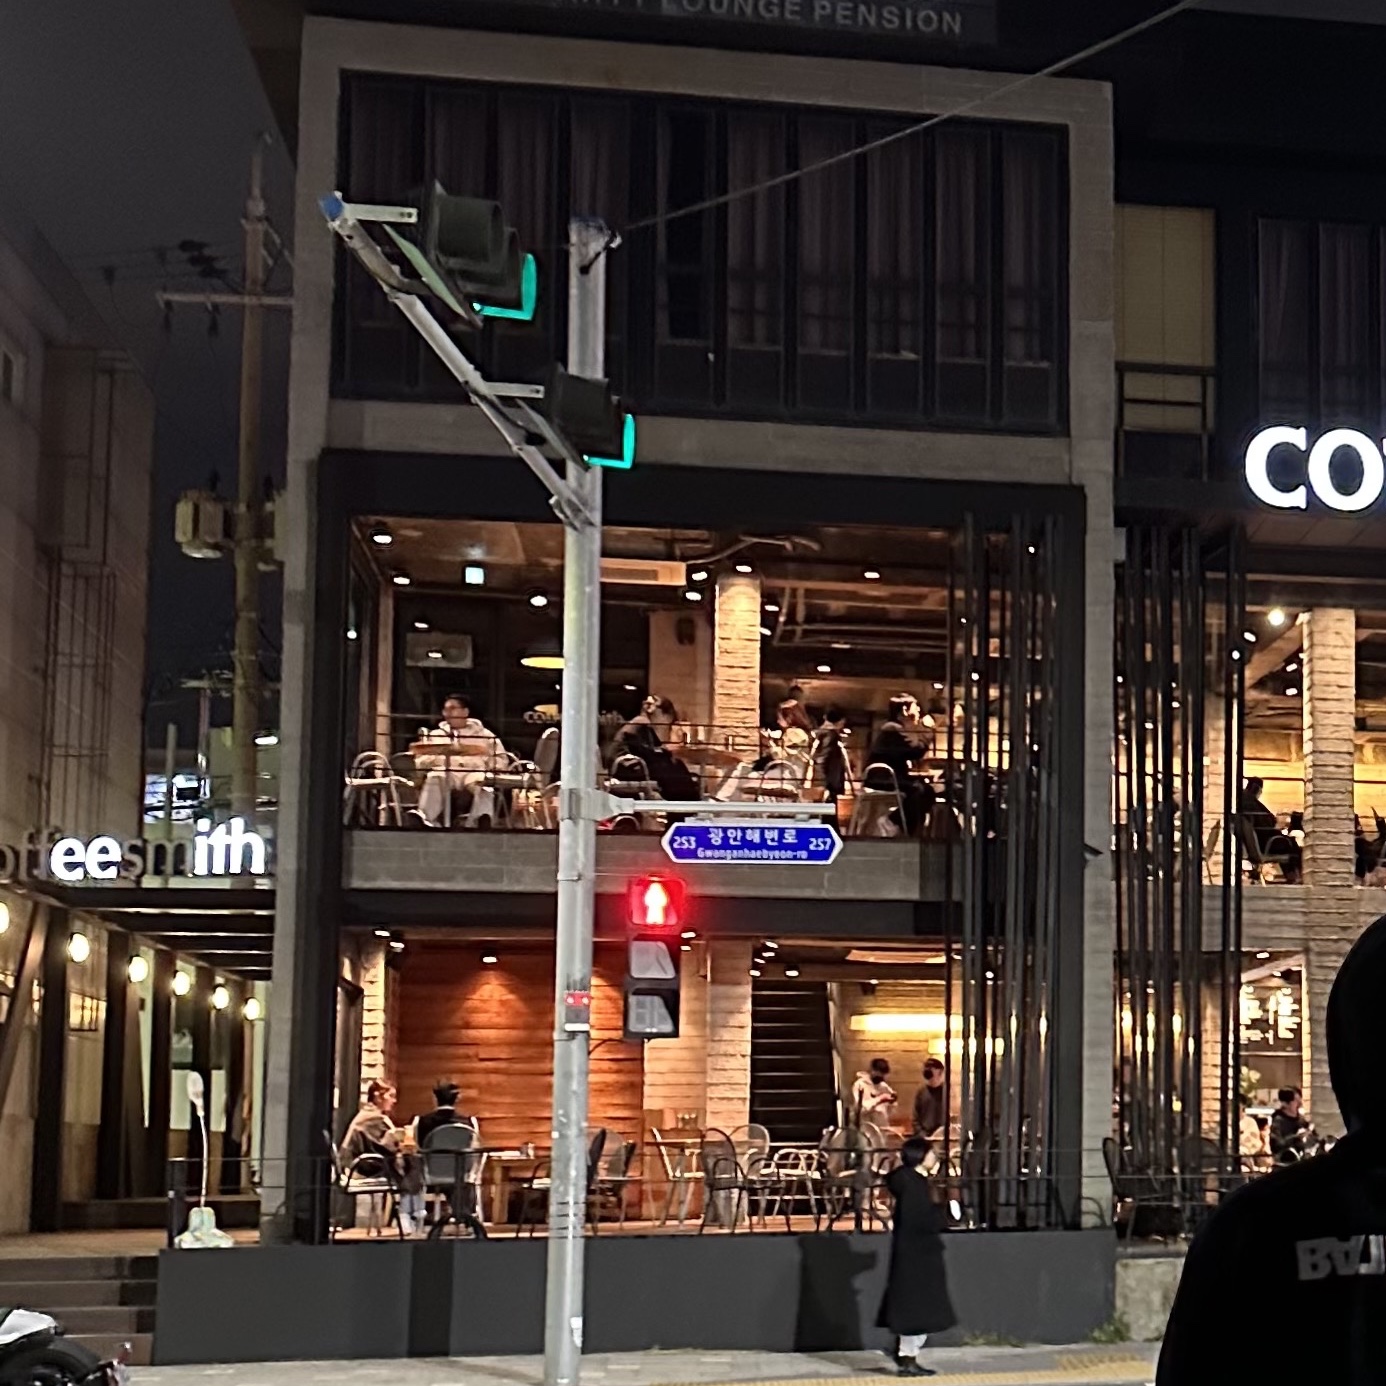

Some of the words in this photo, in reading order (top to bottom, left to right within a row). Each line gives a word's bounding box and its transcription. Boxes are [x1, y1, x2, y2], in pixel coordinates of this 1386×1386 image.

[815, 0, 963, 35] PENSION
[672, 835, 697, 850] 253
[707, 828, 799, 846] 광안해변로
[808, 837, 832, 851] 257
[697, 847, 808, 861] Gwanganhaebyeon-ro
